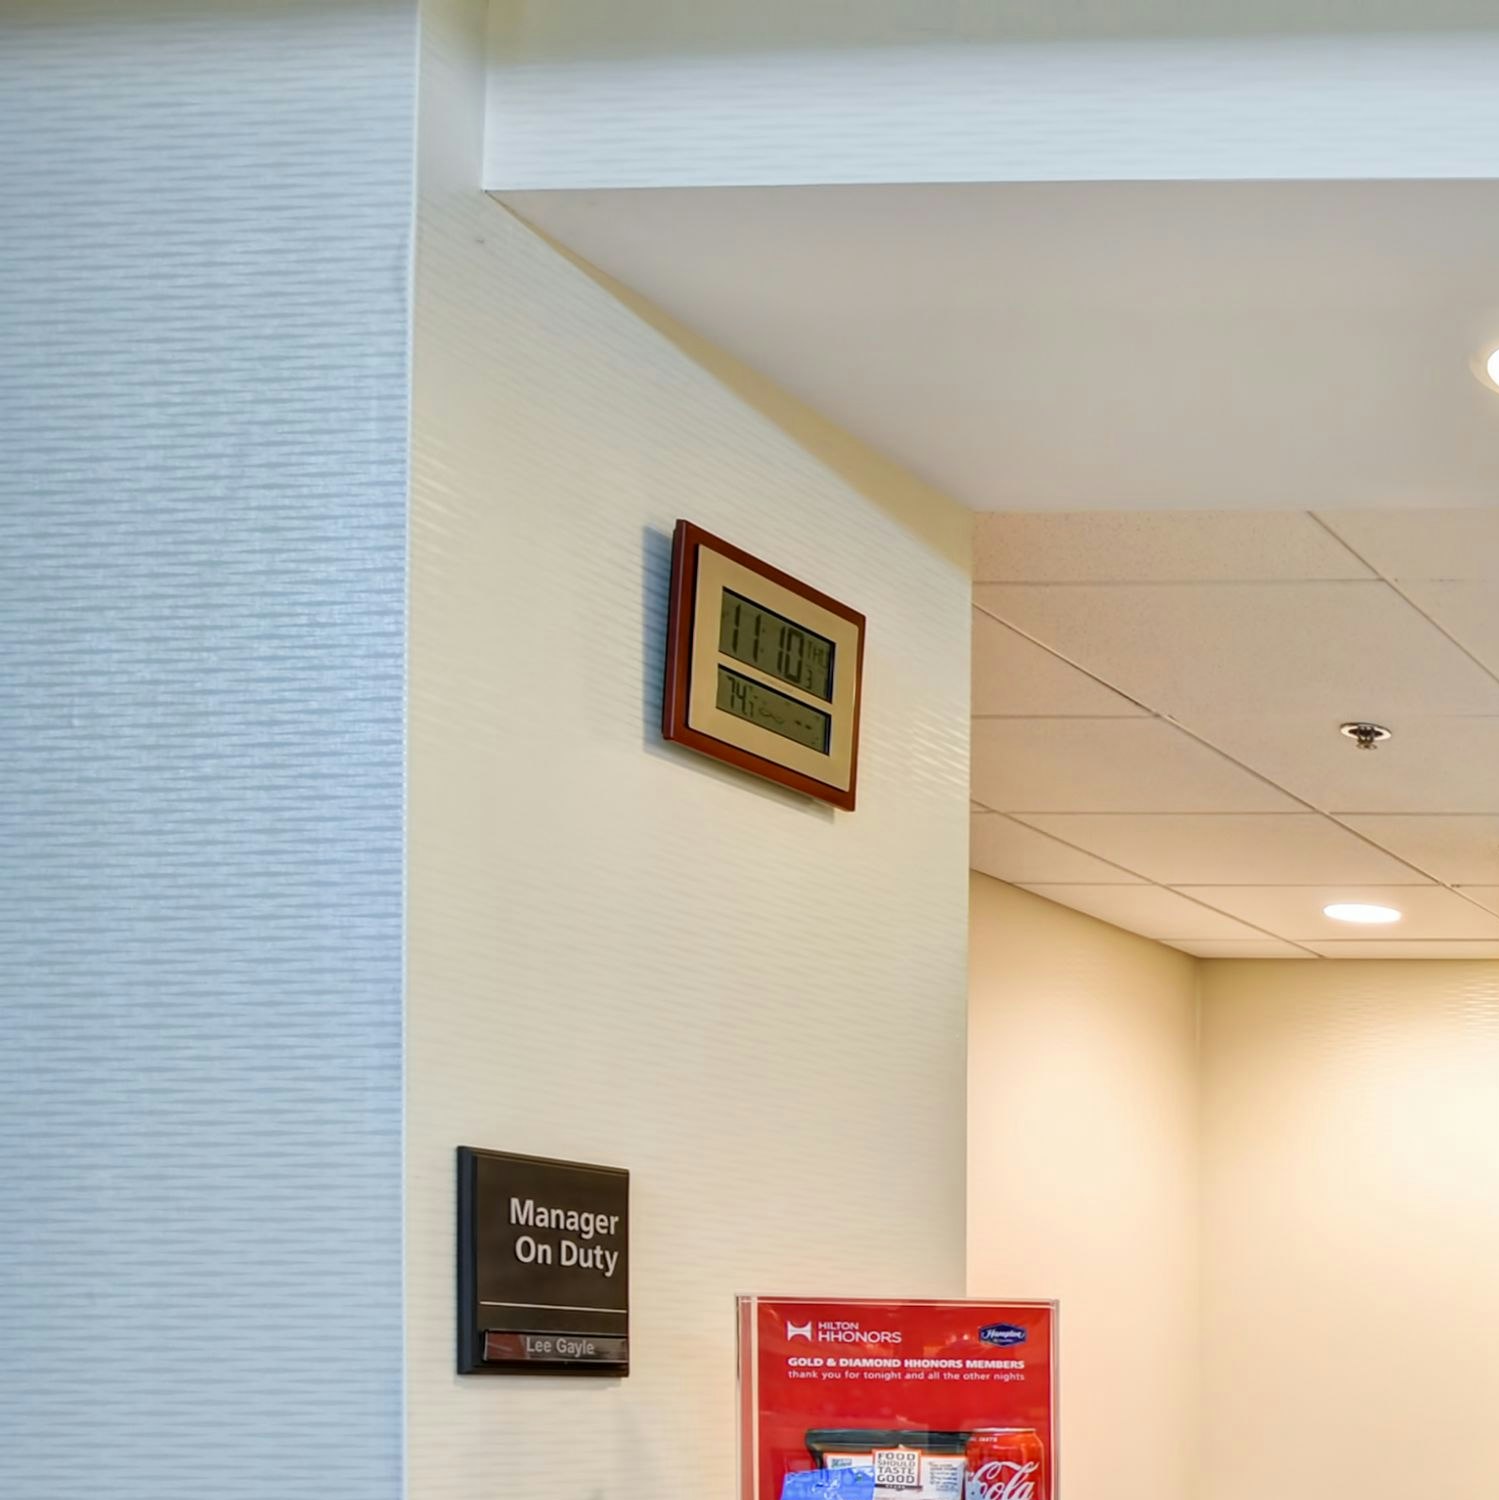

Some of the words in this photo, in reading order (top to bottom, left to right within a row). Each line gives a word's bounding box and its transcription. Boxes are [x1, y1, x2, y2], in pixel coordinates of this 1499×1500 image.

[510, 1197, 619, 1239] Manager
[515, 1236, 552, 1265] On
[560, 1240, 618, 1277] Duty
[818, 1321, 859, 1330] HILTON
[818, 1330, 902, 1343] HHONORS
[526, 1336, 553, 1353] Lee
[556, 1338, 596, 1357] Gayle
[788, 1357, 823, 1367] GOLD
[826, 1358, 837, 1367] &
[839, 1358, 901, 1368] DIAMOND
[904, 1359, 963, 1369] HHONORS
[965, 1360, 1025, 1369] MEMBERS
[788, 1370, 818, 1379] thank
[821, 1371, 841, 1380] you
[844, 1370, 860, 1379] for
[863, 1370, 901, 1381] tonight
[904, 1371, 925, 1380] and
[927, 1371, 940, 1380] all
[943, 1371, 960, 1380] the
[963, 1371, 990, 1380] other
[994, 1372, 1025, 1382] nights
[878, 1452, 916, 1461] FOOD
[878, 1466, 914, 1474] TASTE
[877, 1474, 915, 1484] GOOD
